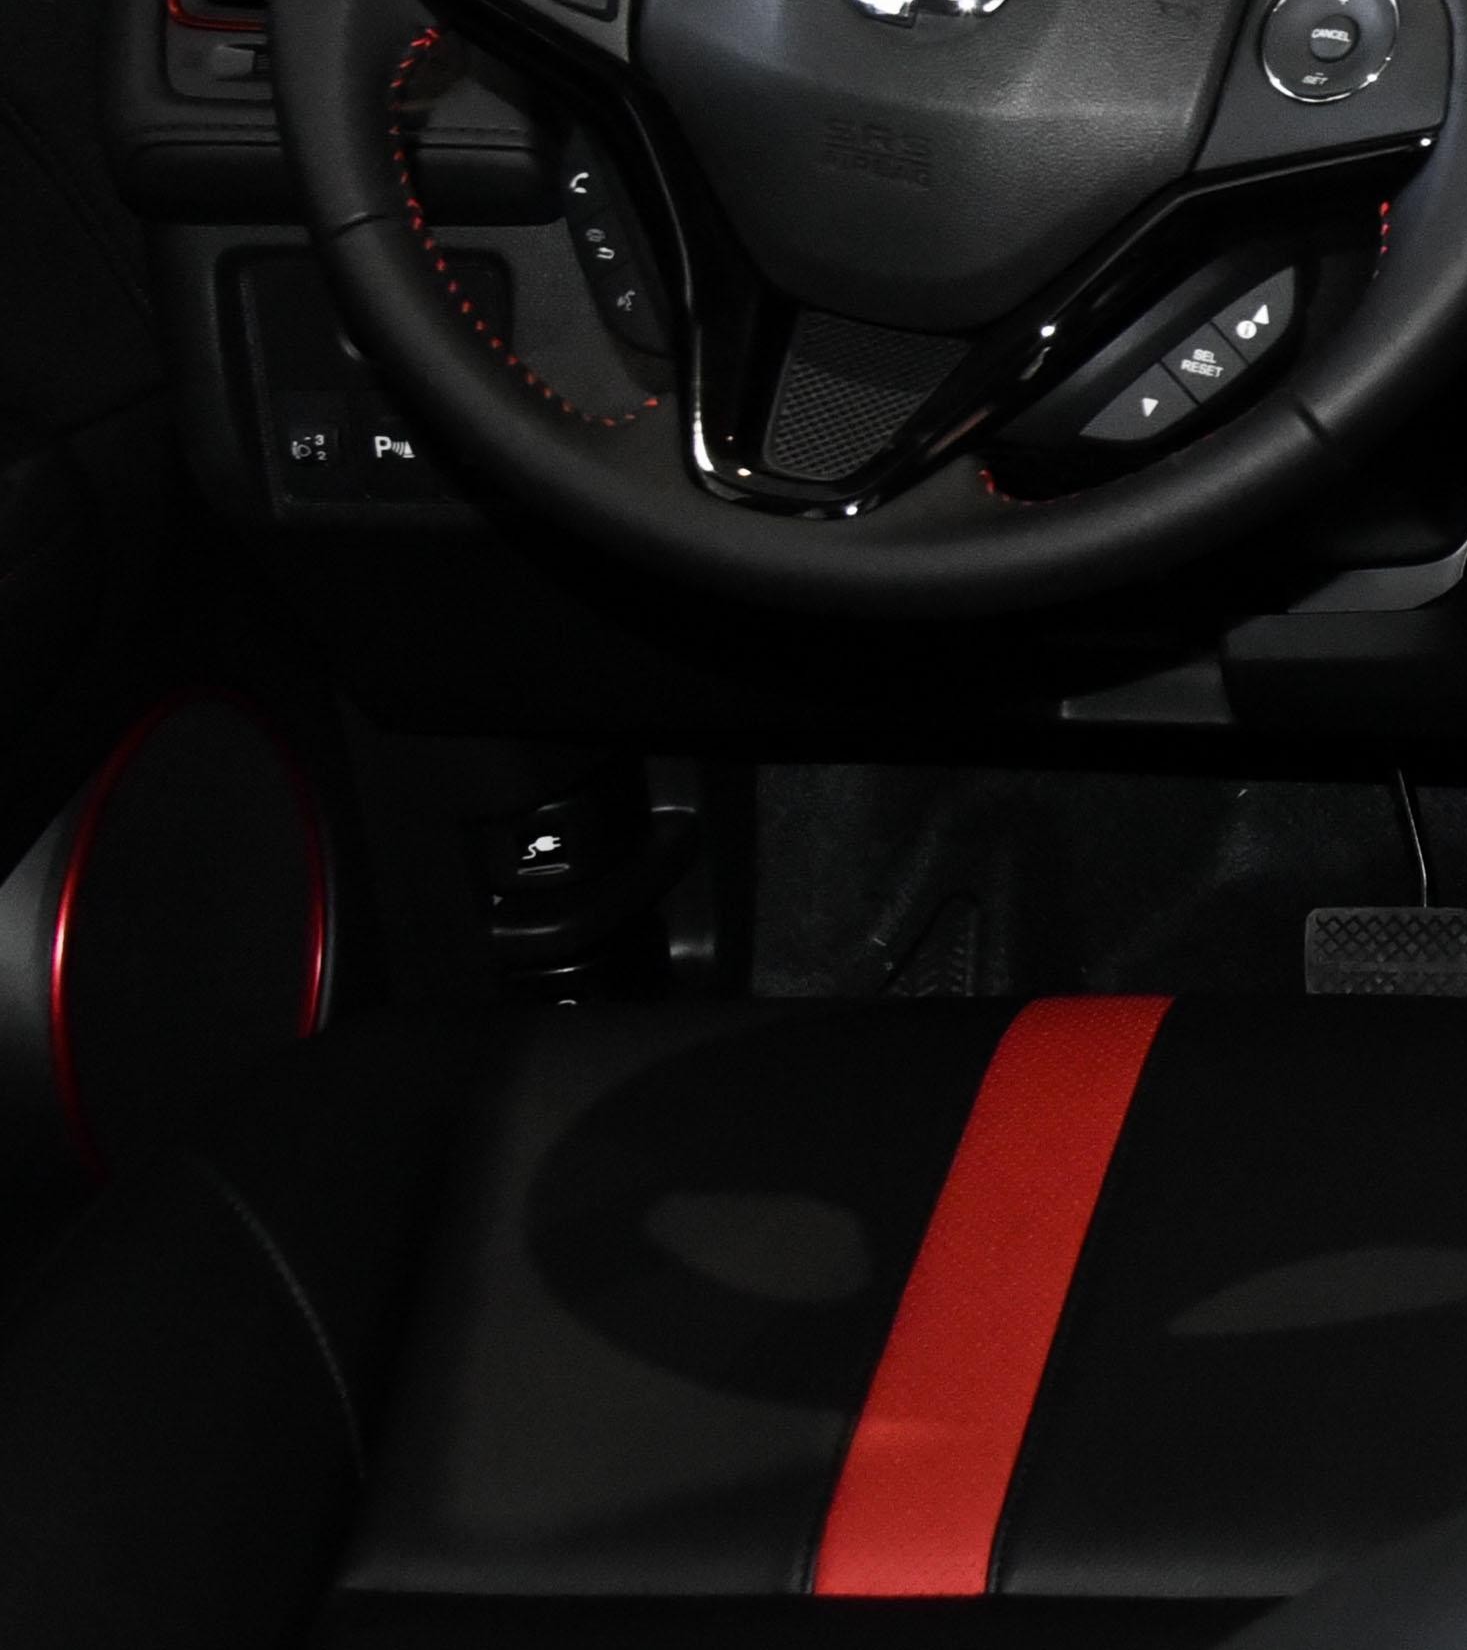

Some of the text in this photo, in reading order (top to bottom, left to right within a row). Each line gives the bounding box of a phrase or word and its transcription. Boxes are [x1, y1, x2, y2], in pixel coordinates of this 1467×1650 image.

[1310, 28, 1351, 43] CANCEL
[1193, 348, 1217, 364] SEL
[1181, 359, 1224, 378] RESET
